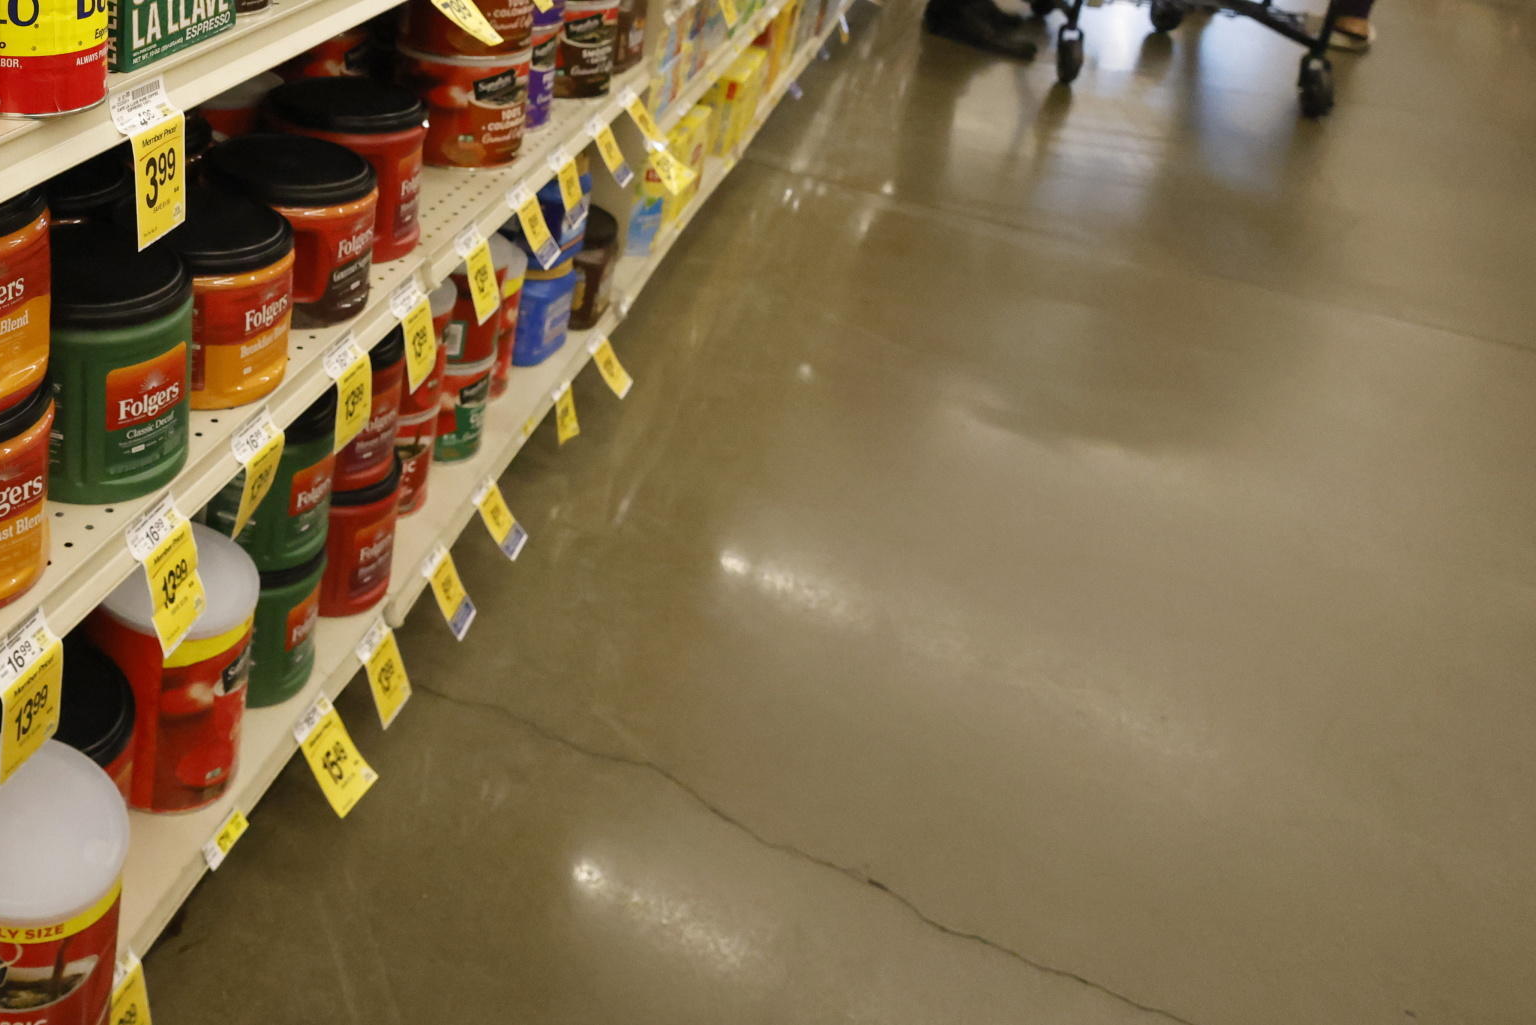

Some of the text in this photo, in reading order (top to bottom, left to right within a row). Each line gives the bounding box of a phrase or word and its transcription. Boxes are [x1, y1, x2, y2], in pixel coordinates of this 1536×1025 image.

[132, 1, 161, 50] LA
[185, 11, 230, 40] ESPRESSO
[244, 292, 289, 333] Folgers
[117, 381, 180, 421] Folgers
[126, 412, 178, 441] Classic Decaf
[25, 926, 64, 939] SIZE
